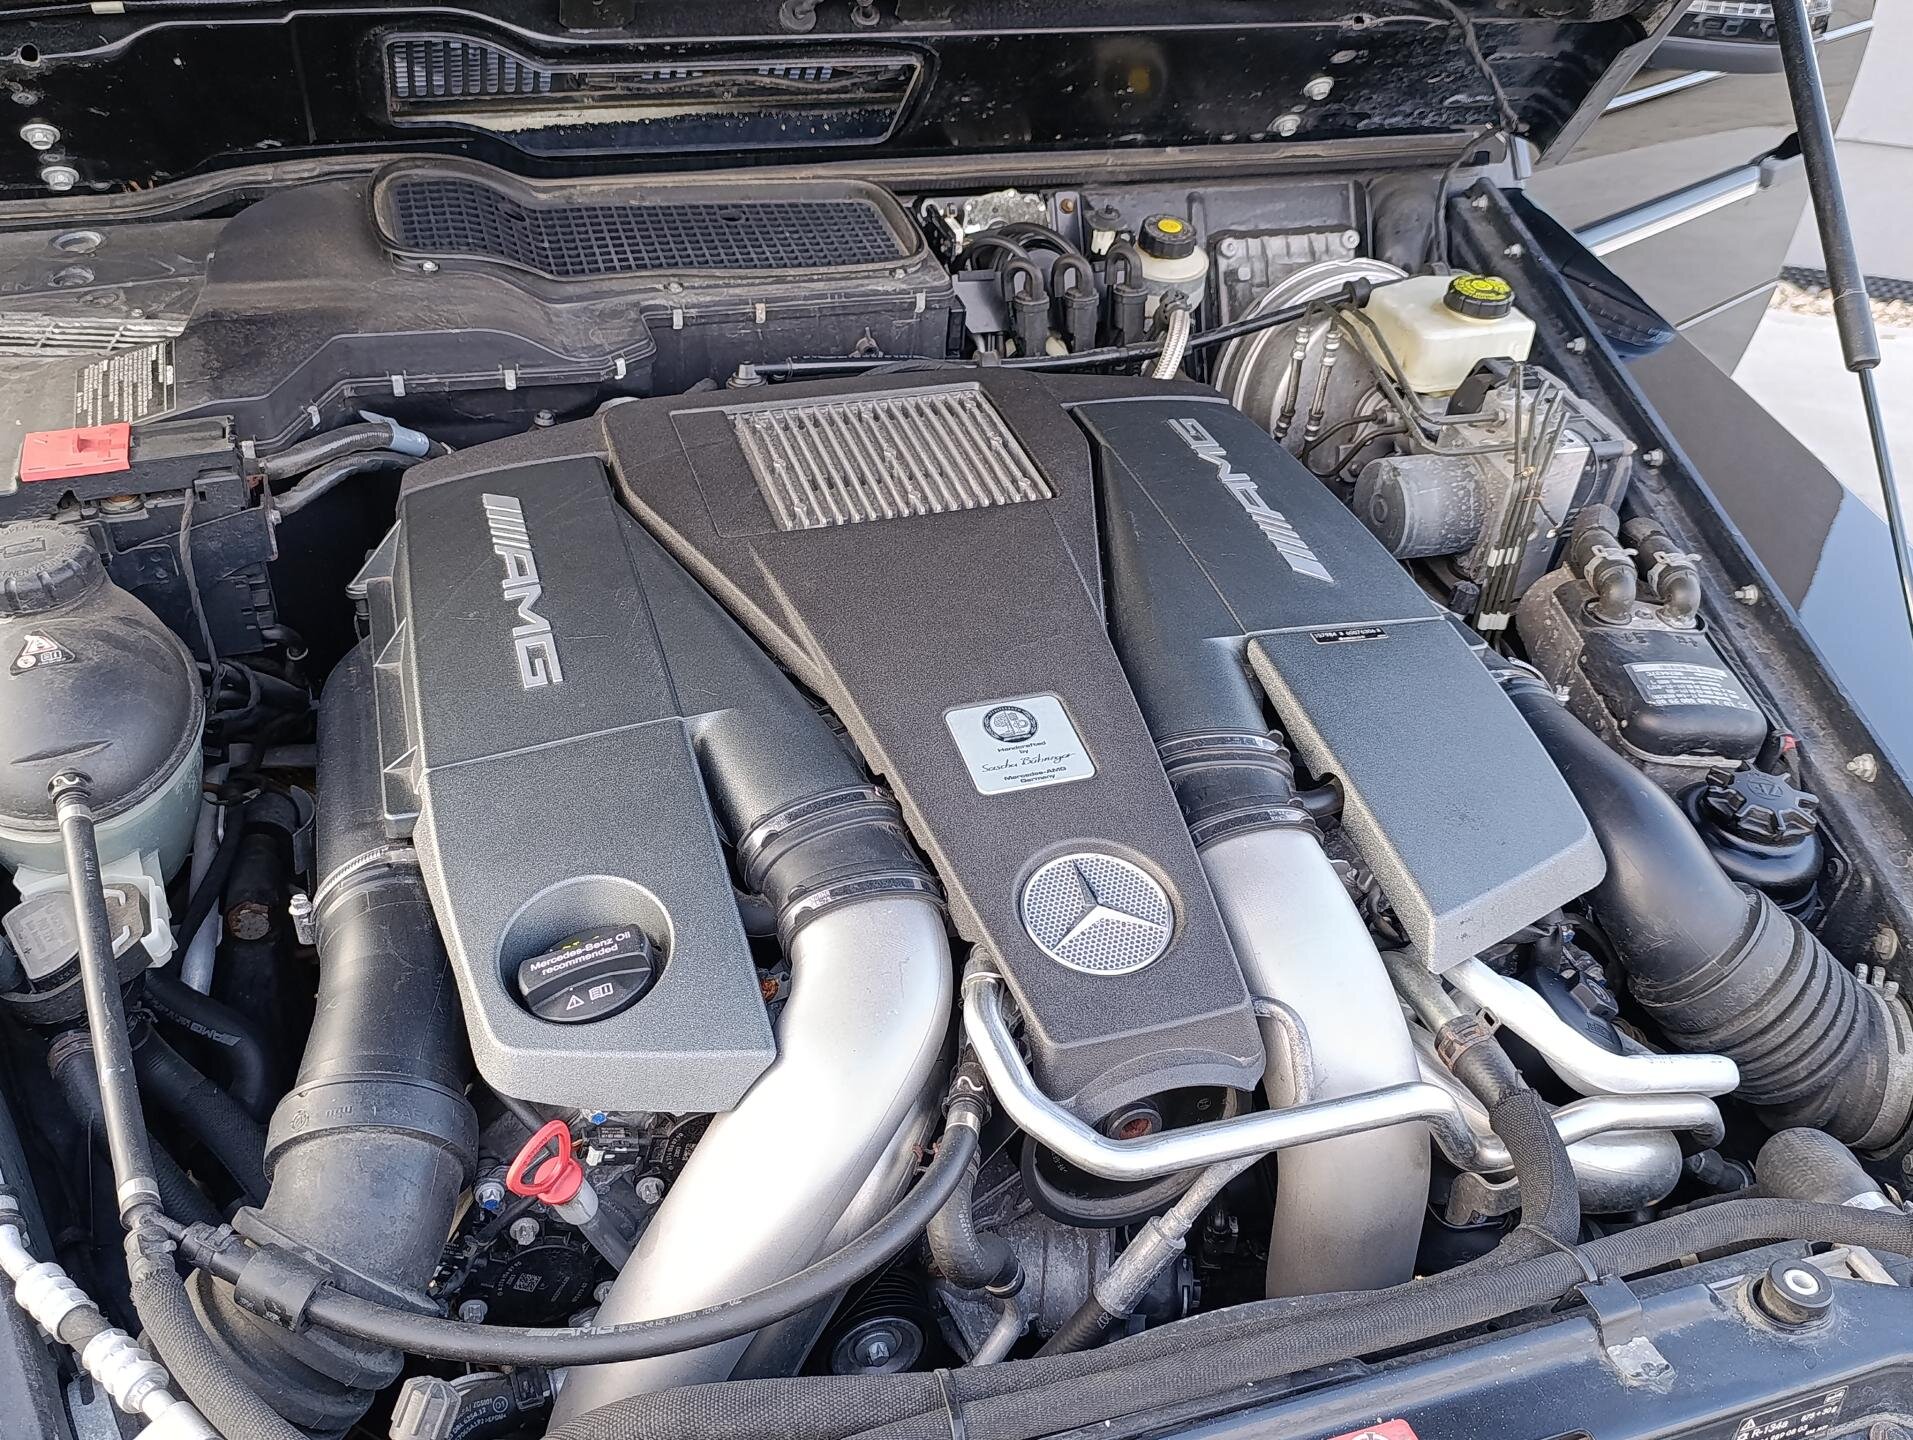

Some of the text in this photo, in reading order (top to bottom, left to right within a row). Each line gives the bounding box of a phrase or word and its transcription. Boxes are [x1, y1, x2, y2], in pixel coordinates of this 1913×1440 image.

[494, 545, 564, 689] AMG
[997, 741, 1047, 753] Handcrafted
[1003, 766, 1067, 782] Mercedes-AMG
[1020, 774, 1056, 784] Germany
[530, 931, 631, 972] Mercedes-Benz Oil
[542, 944, 619, 976] recommended
